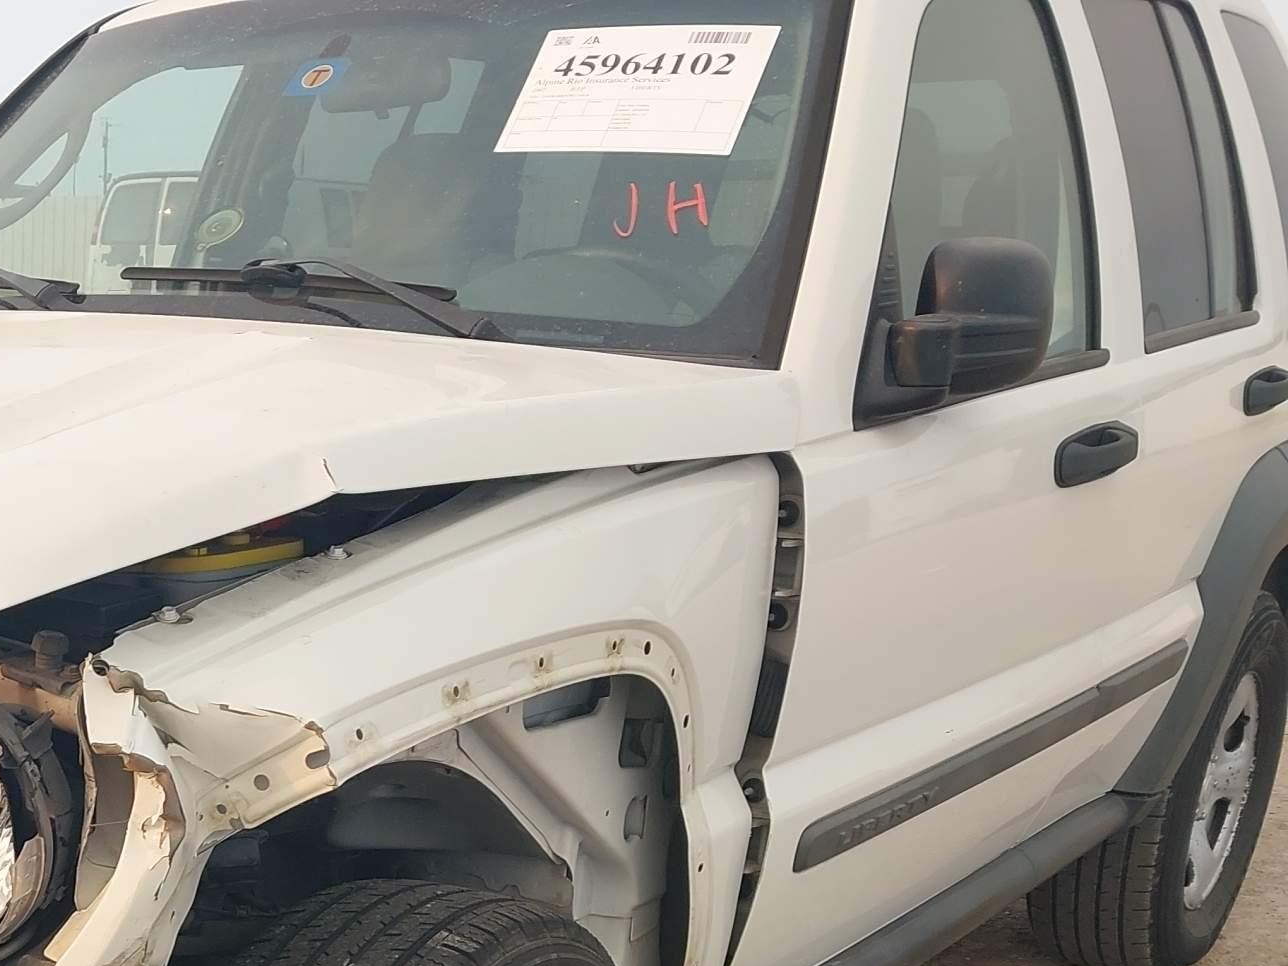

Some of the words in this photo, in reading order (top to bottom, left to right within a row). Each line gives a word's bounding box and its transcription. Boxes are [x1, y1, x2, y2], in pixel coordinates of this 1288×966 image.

[554, 53, 736, 76] 45964102
[613, 182, 639, 237] J
[666, 181, 709, 234] H
